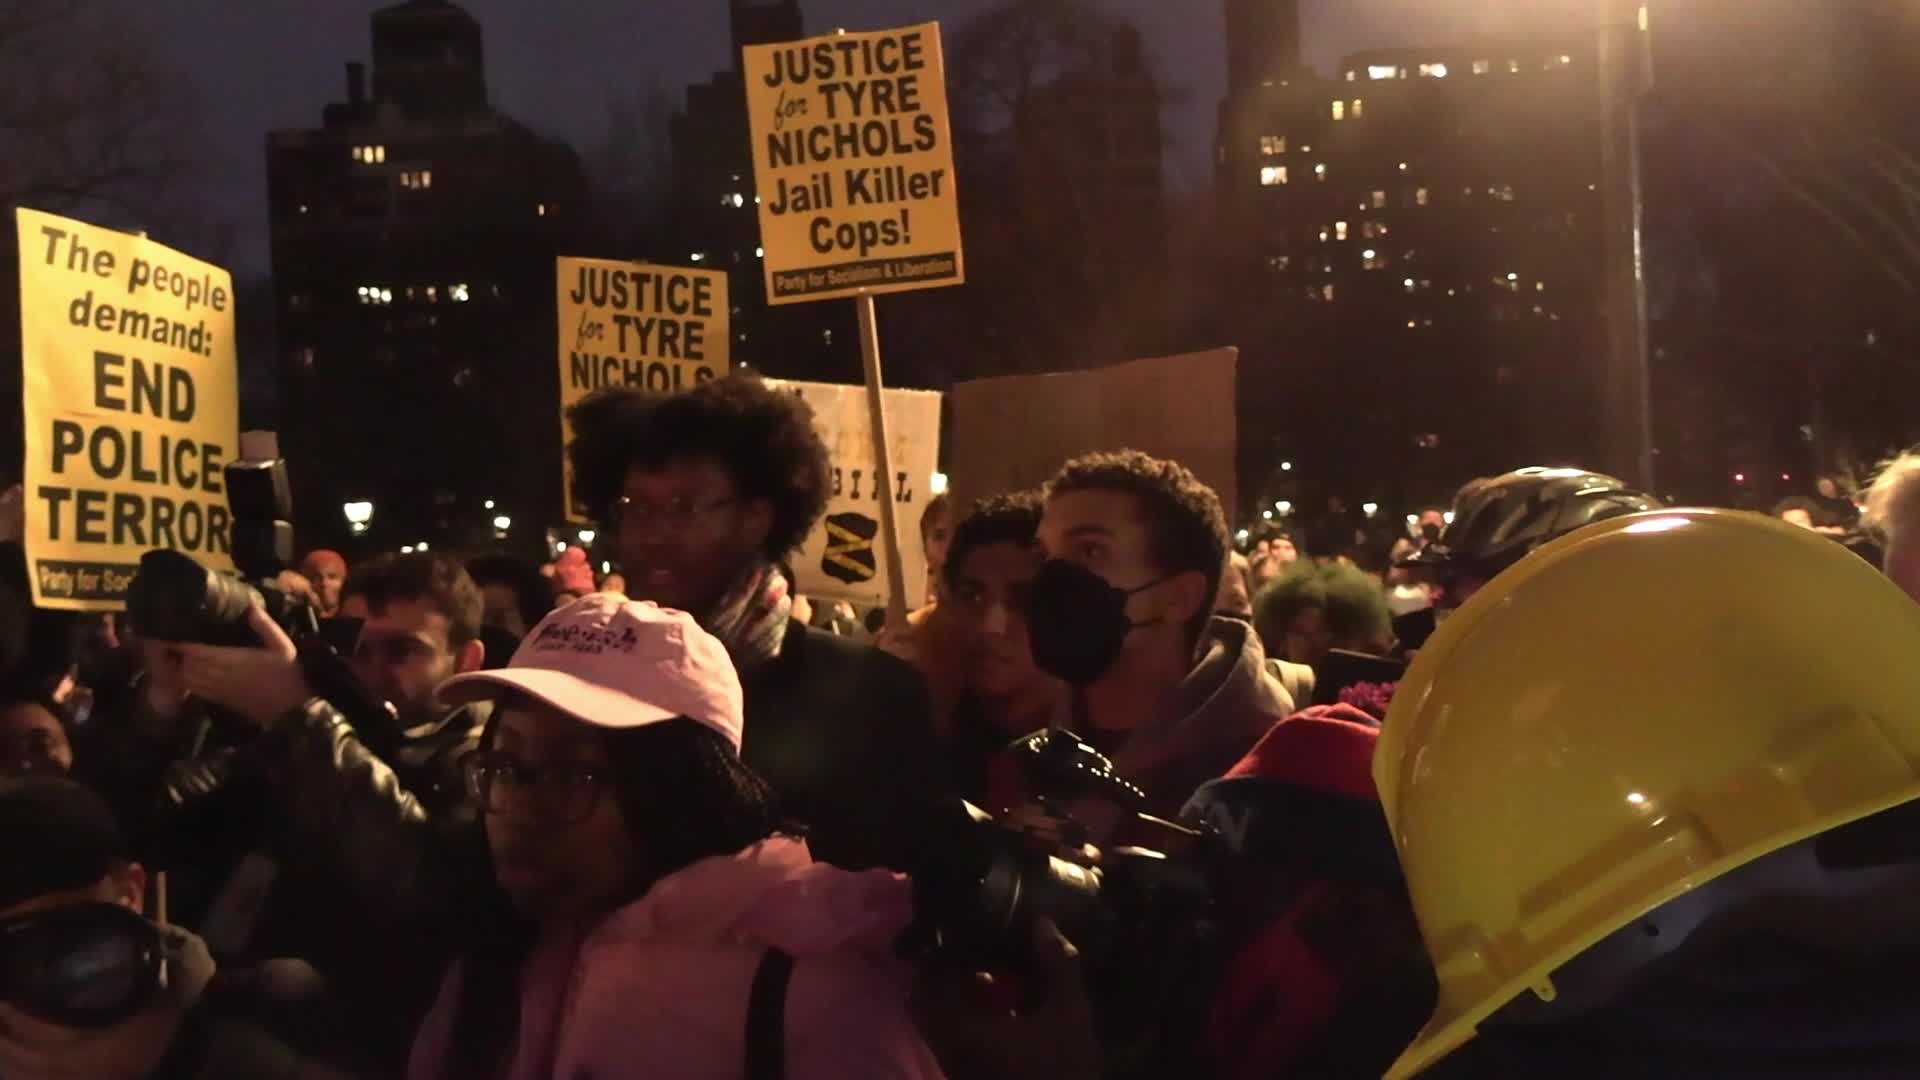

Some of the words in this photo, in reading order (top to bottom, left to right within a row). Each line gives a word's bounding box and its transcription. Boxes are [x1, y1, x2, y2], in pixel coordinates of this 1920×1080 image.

[763, 33, 925, 88] JUSTICE
[773, 89, 808, 130] for
[818, 75, 921, 119] TYRE
[767, 114, 937, 168] NICHOLS
[769, 172, 833, 216] Jail
[845, 165, 945, 206] Killer
[809, 208, 911, 257] Cops!
[40, 225, 116, 278] The
[127, 257, 227, 312] people
[570, 266, 713, 317] JUSTICE
[69, 291, 212, 357] demand:
[575, 309, 604, 350] for
[613, 314, 705, 361] TYRE
[94, 350, 196, 423] END
[51, 418, 223, 494] POLICE
[38, 485, 230, 554] TERROR
[40, 566, 74, 597] Party
[77, 568, 100, 591] for
